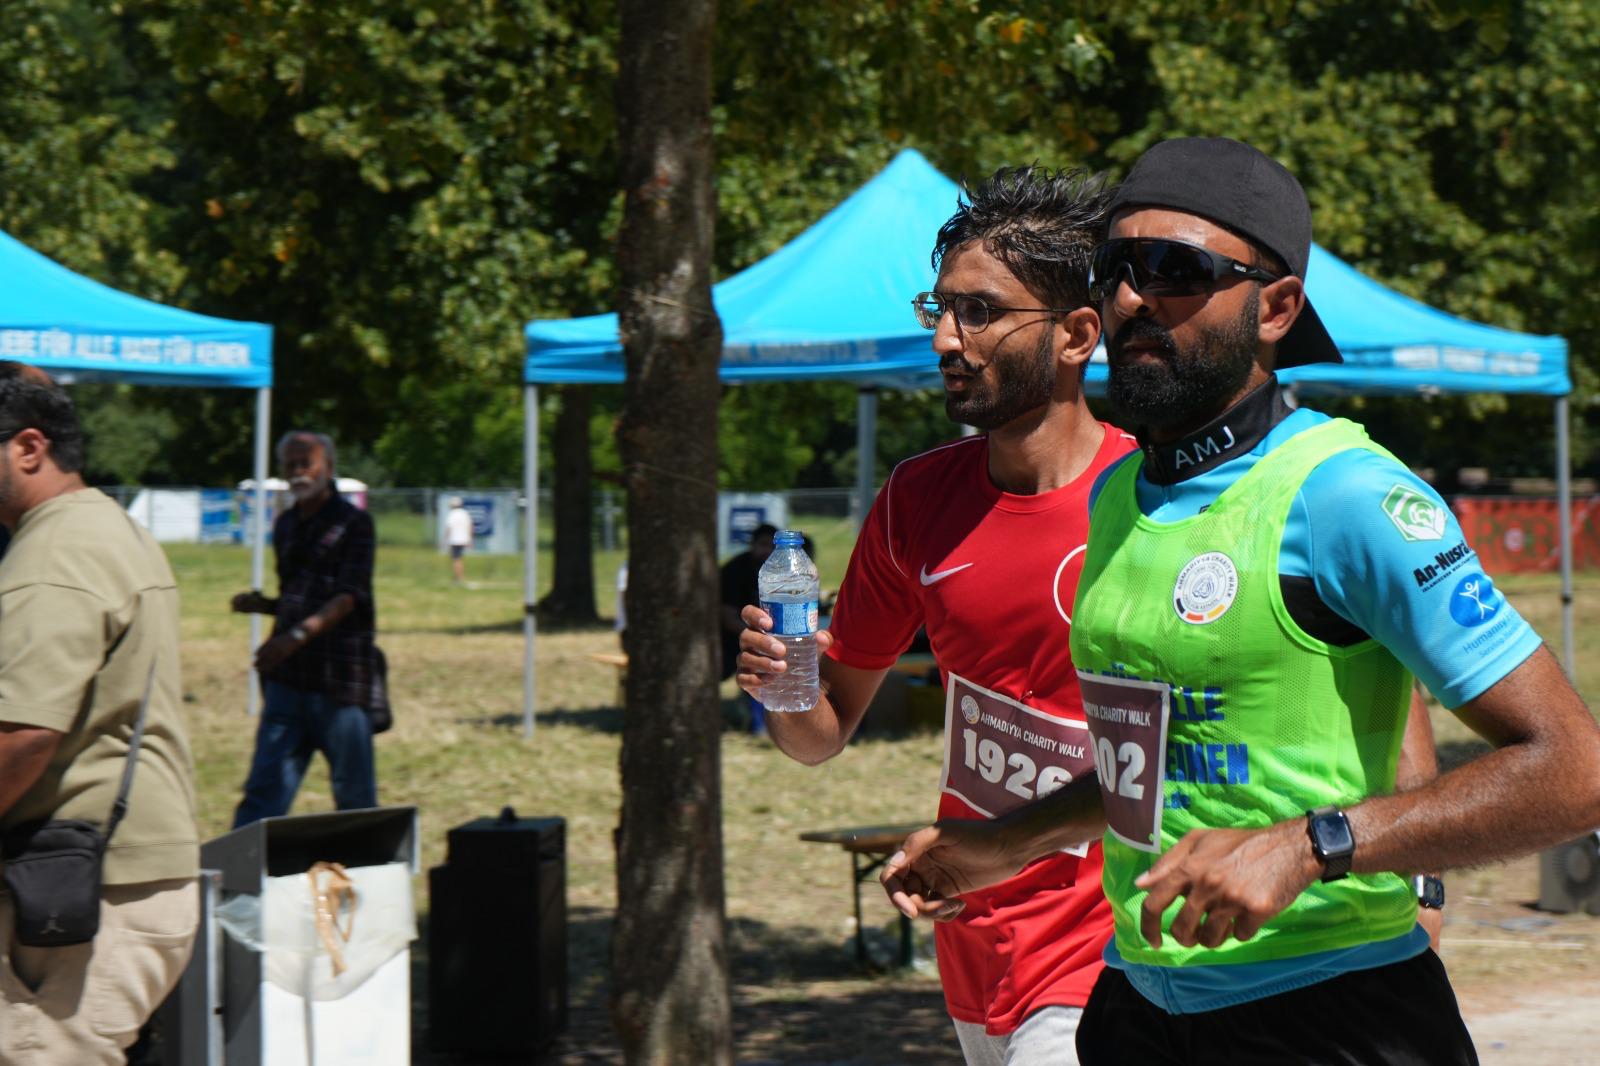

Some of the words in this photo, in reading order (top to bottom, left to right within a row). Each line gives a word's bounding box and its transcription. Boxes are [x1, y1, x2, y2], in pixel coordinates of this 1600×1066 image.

[1175, 425, 1236, 470] AMJ
[1100, 705, 1127, 724] CHARITY
[1128, 709, 1151, 728] WALK
[1152, 678, 1225, 721] LLE
[980, 711, 1022, 739] AHMADIYYA
[1023, 730, 1058, 752] CHARITY
[1058, 742, 1085, 760] WALK
